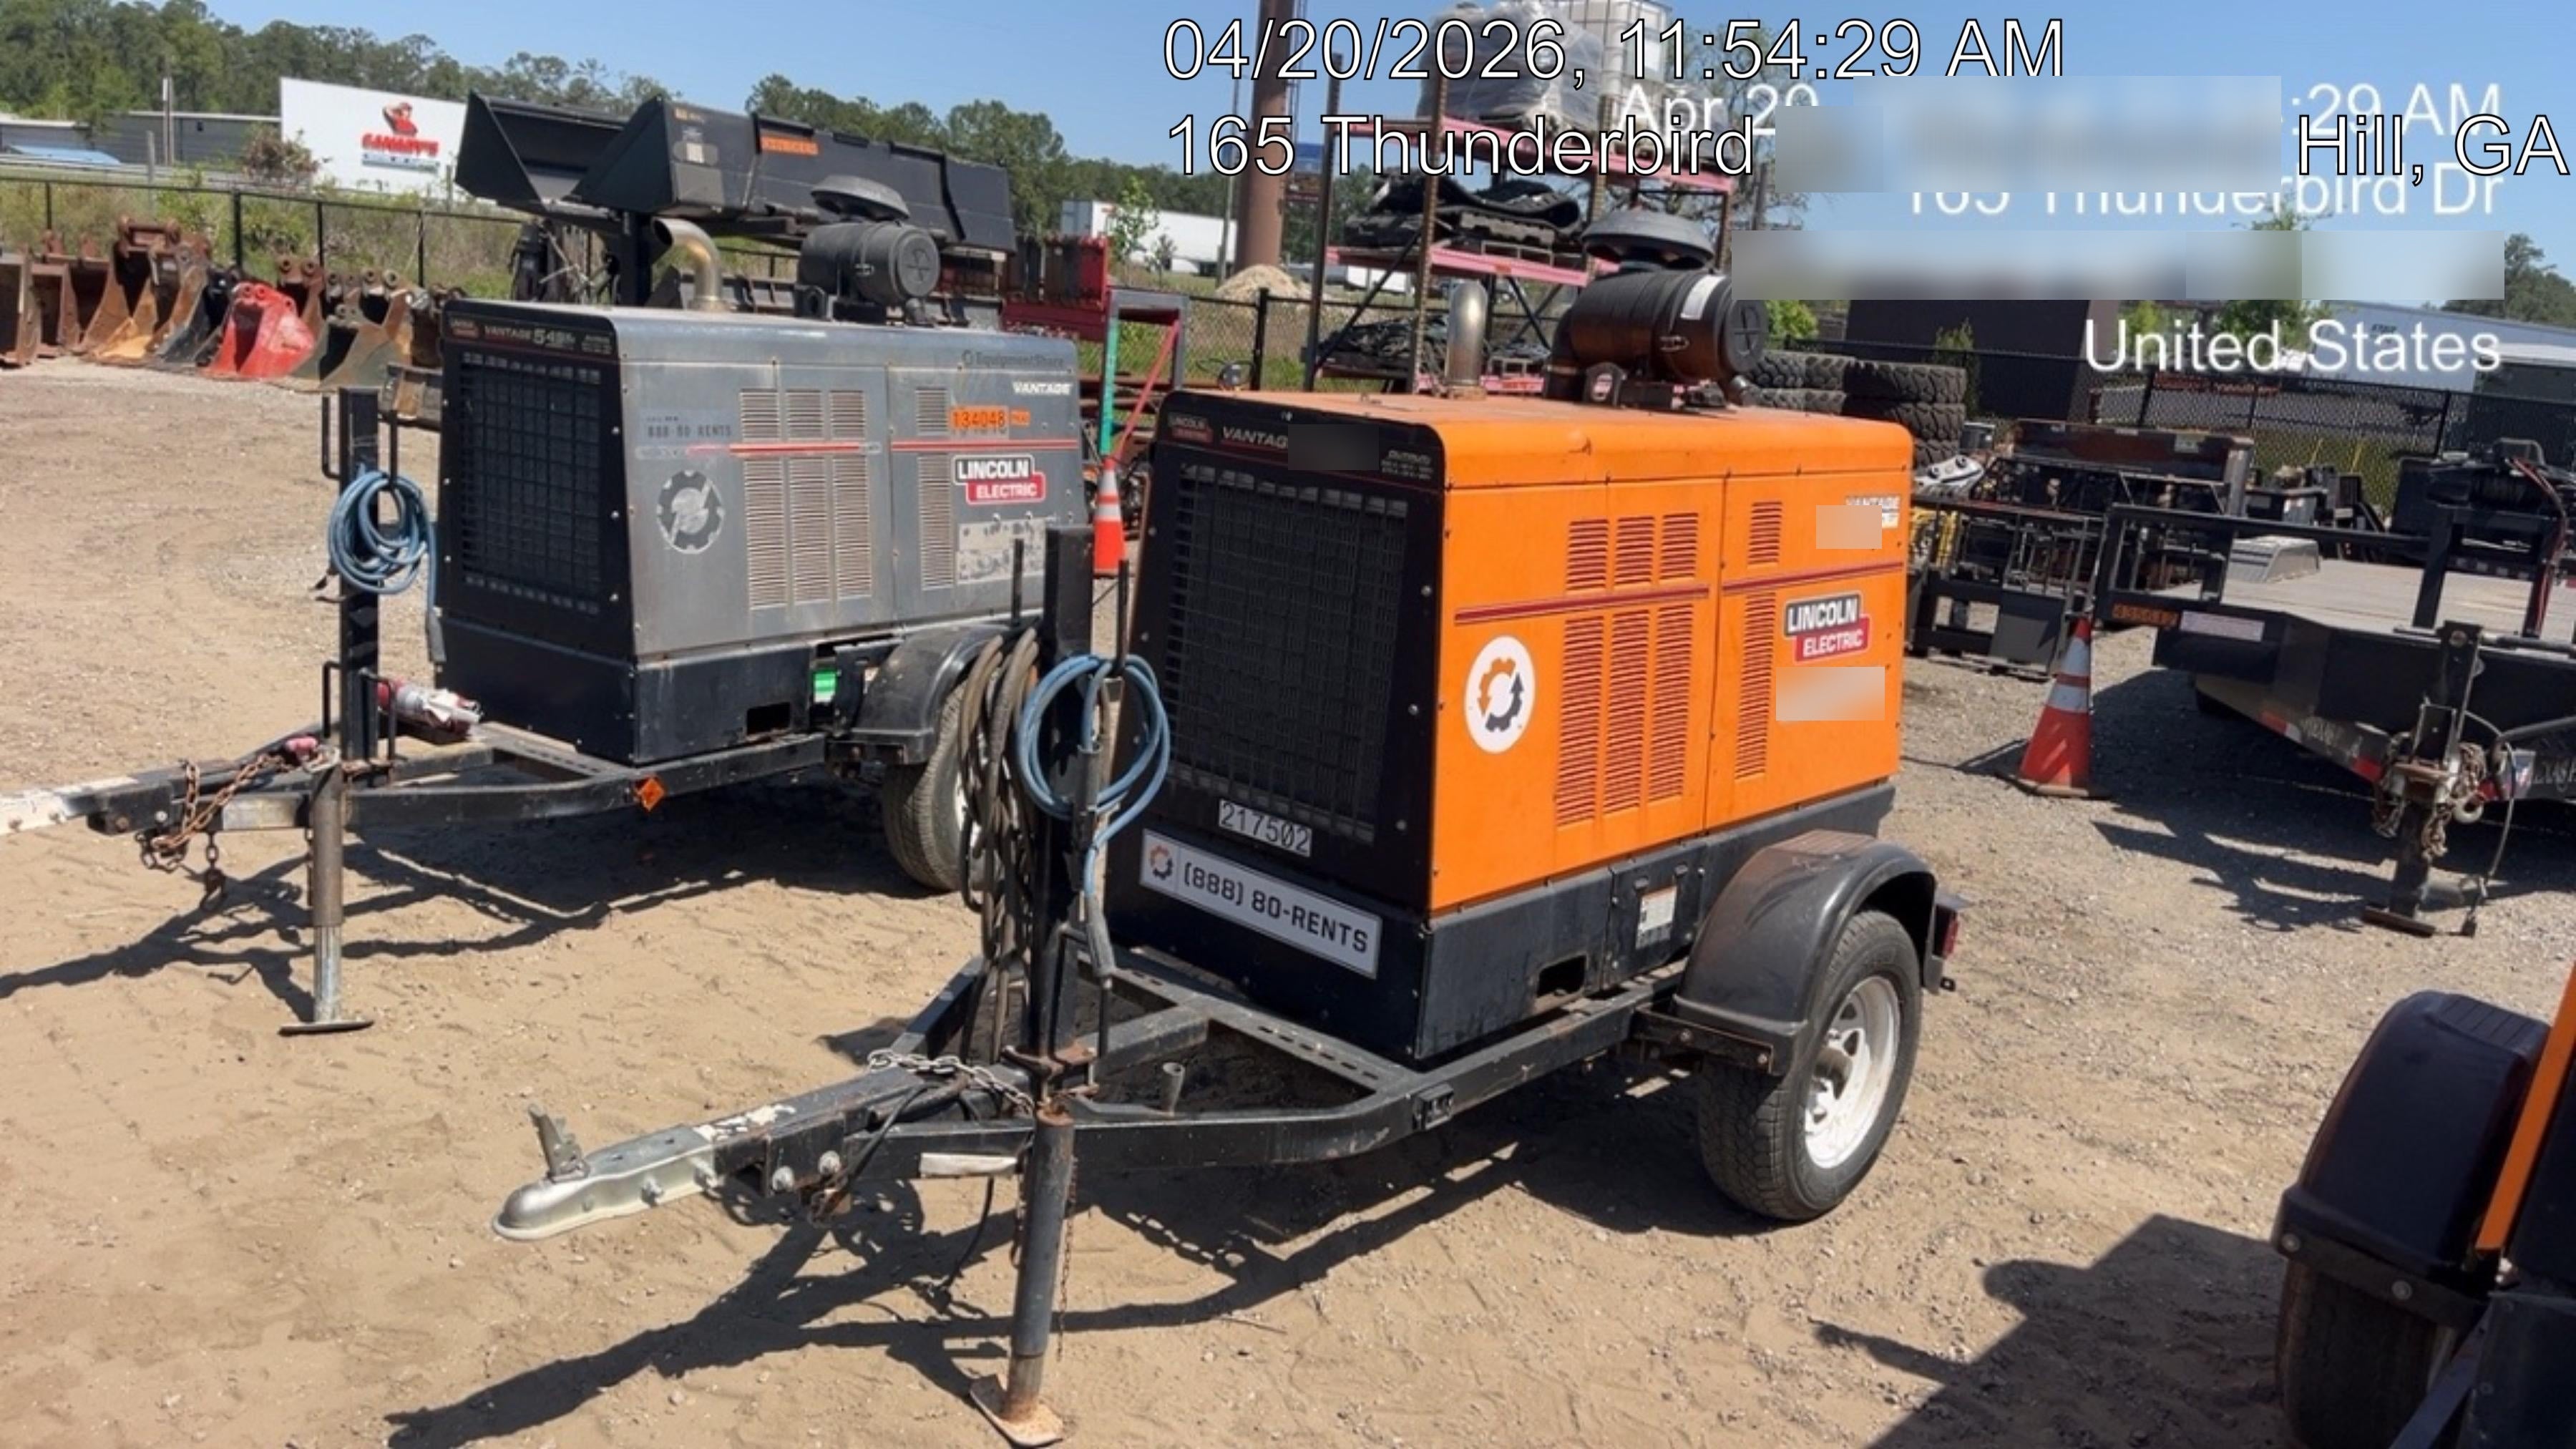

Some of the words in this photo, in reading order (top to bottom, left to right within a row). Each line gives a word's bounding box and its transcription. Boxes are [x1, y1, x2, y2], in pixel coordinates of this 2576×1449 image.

[975, 349, 1064, 369] EquipmentShare
[1013, 381, 1073, 396] VANTAGE
[1223, 426, 1289, 449] VANTAG
[958, 459, 1029, 479] LINCOLN
[976, 482, 1038, 499] ELECTRIC
[1787, 598, 1859, 633] LINCOLN
[1802, 628, 1865, 658] ELECTRIC
[1220, 802, 1310, 854] 217502
[1184, 862, 1244, 907] (888)
[1252, 889, 1368, 954] 80-RENTS
